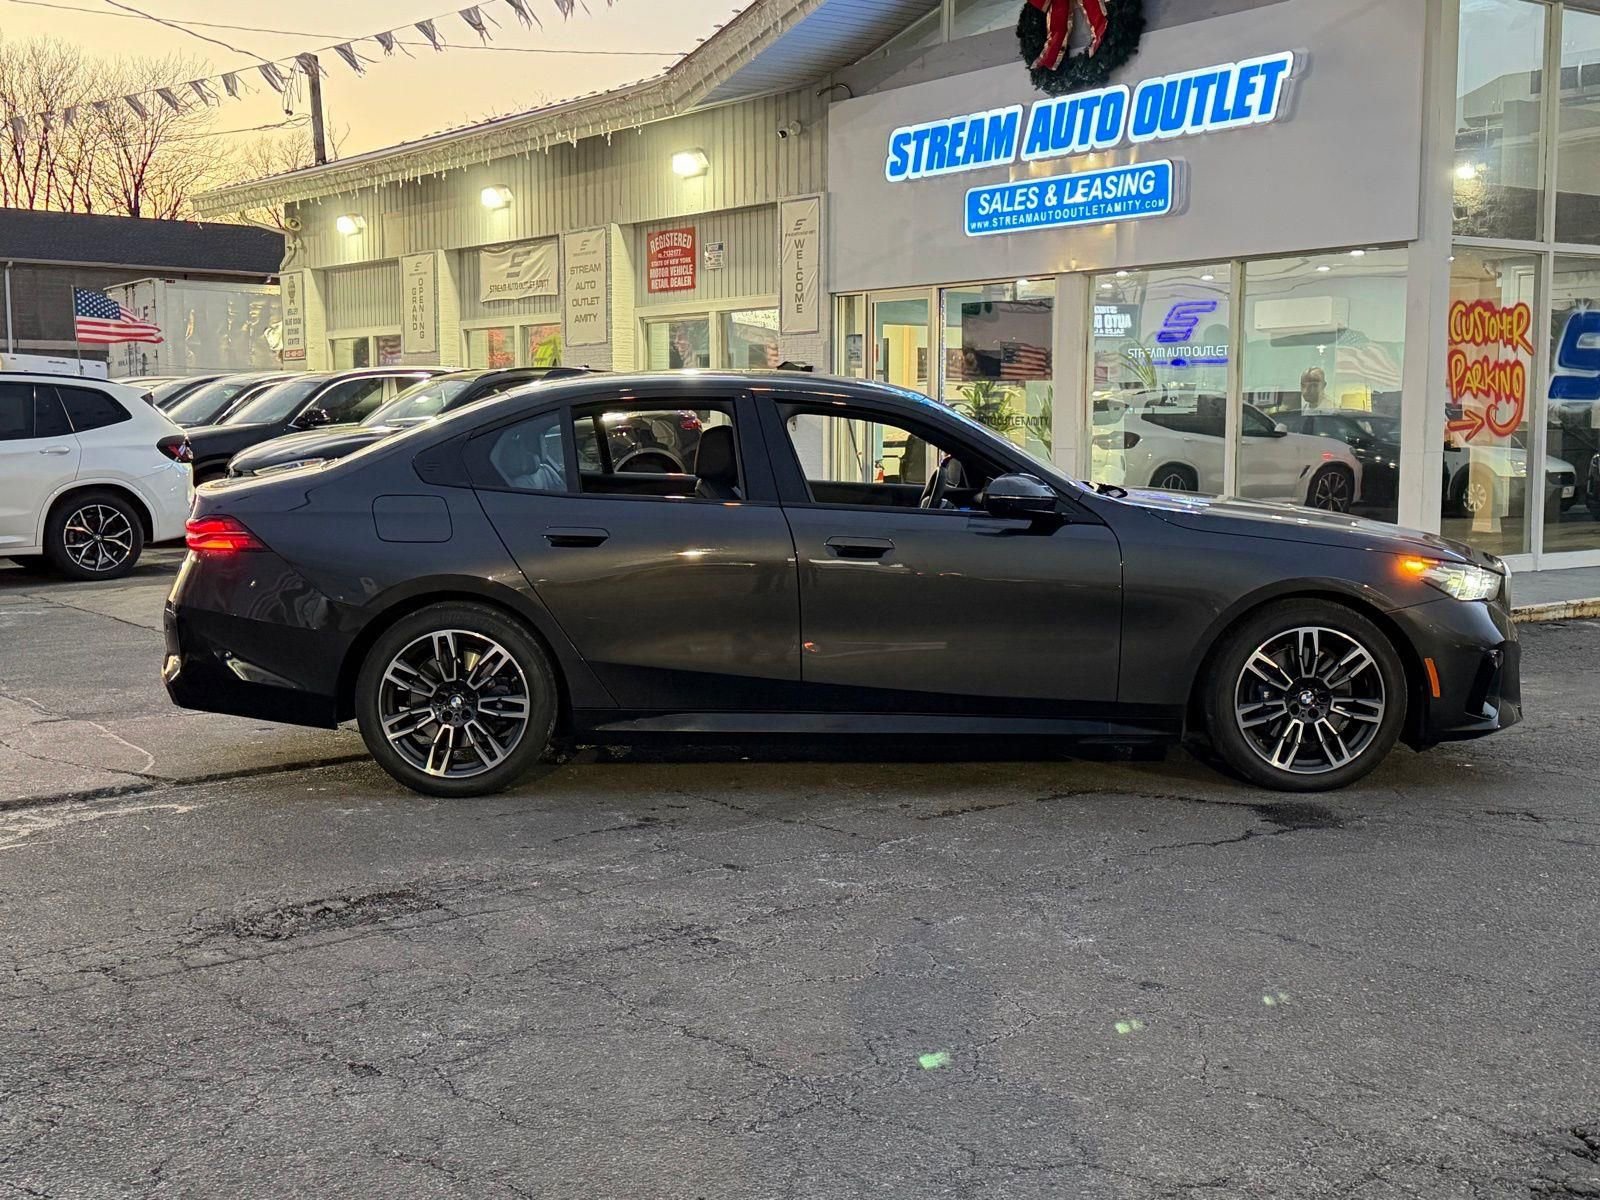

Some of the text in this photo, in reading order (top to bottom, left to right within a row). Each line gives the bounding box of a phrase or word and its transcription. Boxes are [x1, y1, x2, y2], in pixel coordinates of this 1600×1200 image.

[889, 58, 1288, 177] STREAM AUTO OUTLET
[977, 169, 1156, 216] SALES & LEASING
[650, 232, 692, 254] REGISTERED
[570, 262, 601, 275] STREAM
[650, 264, 693, 279] MOTOR VEHICLE
[794, 239, 805, 313] WELCOME
[575, 280, 596, 291] AUTO
[651, 275, 692, 289] RETAIL DEALER
[571, 296, 600, 307] OUTLET
[574, 312, 598, 323] AMITY
[1450, 301, 1534, 355] CUSTOMER
[1166, 346, 1191, 358] AUTO
[1192, 345, 1229, 357] OUTLET
[1448, 350, 1525, 436] PARKING
